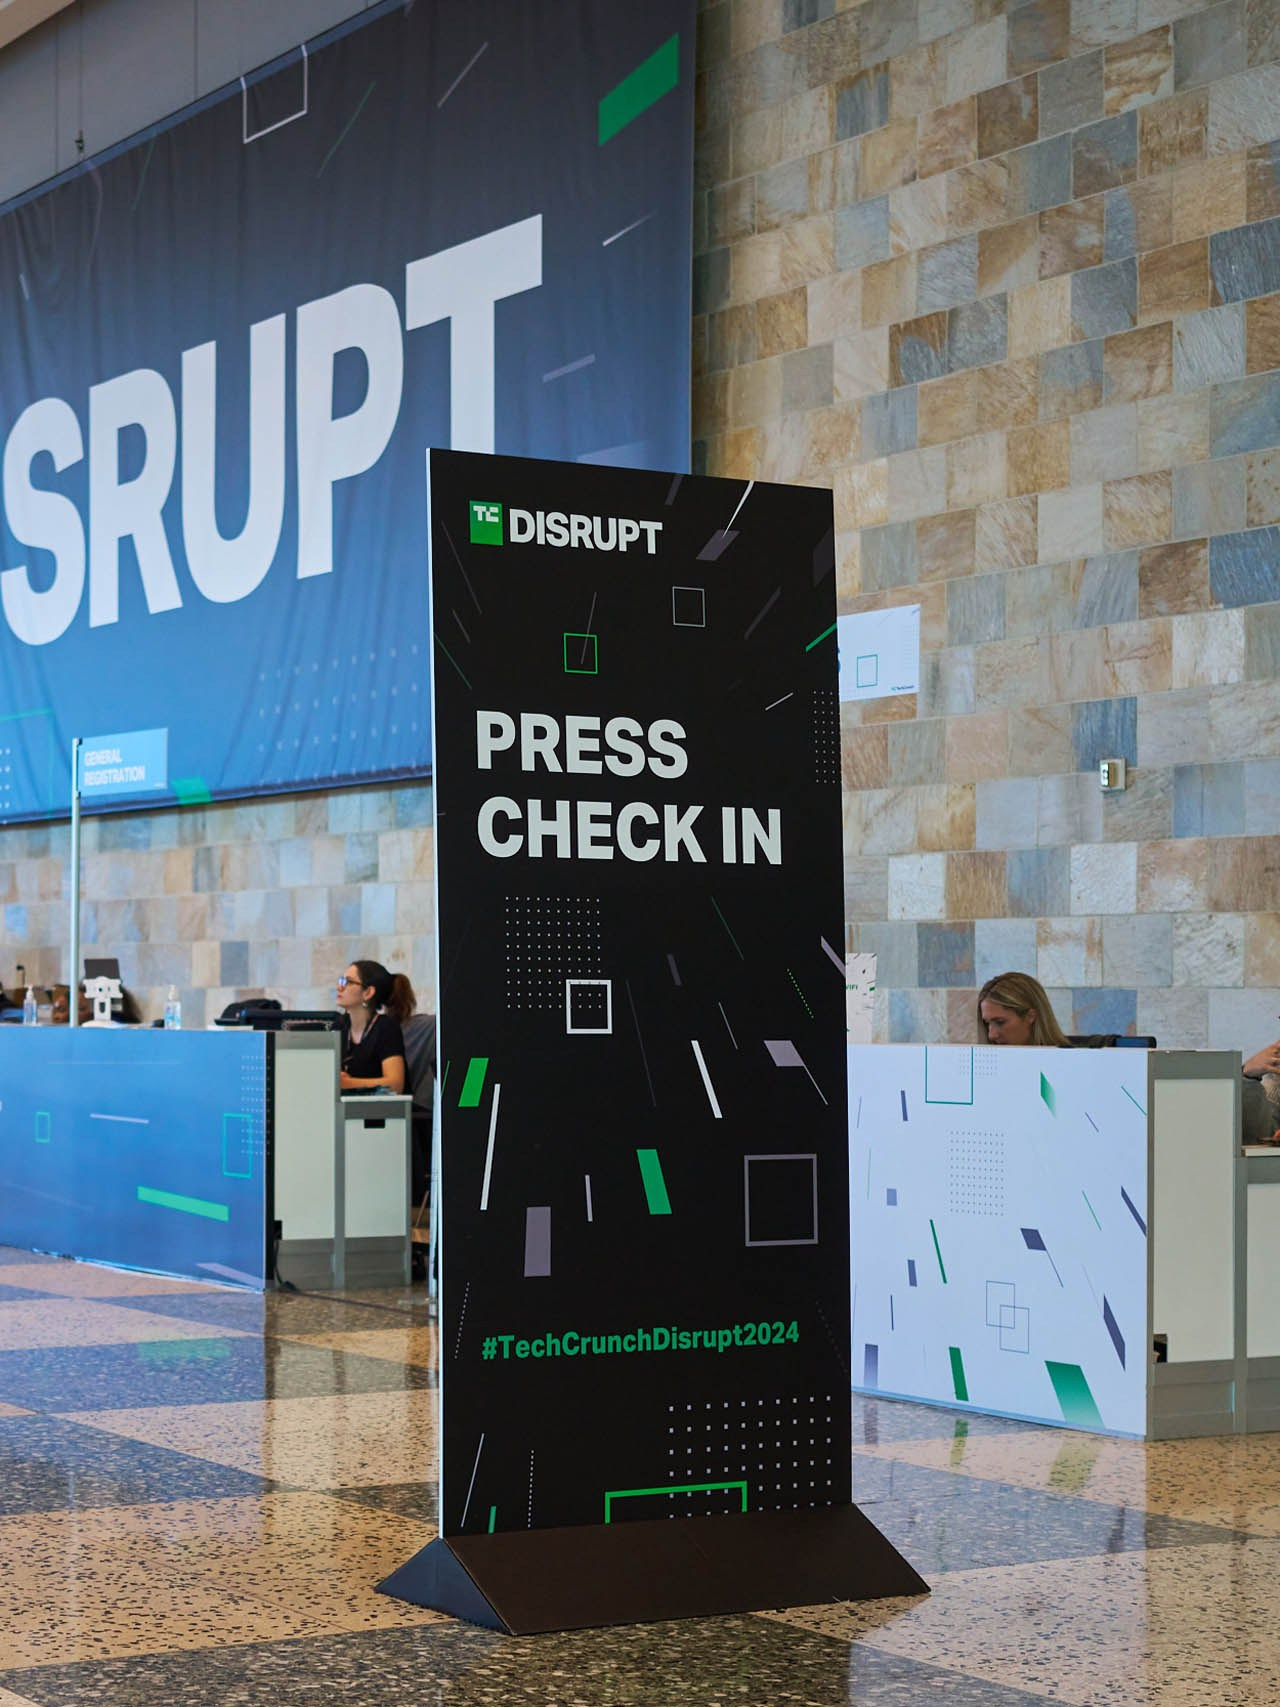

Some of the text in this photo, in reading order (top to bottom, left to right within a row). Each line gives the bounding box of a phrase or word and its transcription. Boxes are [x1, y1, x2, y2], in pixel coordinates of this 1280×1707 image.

[472, 504, 663, 554] TC DISRUPT
[84, 748, 122, 767] GENERAL
[476, 710, 688, 778] PRESS
[84, 766, 144, 786] REGISTRATION
[477, 796, 782, 865] CHECK IN
[482, 1321, 800, 1360] #TechCrunchDisrupt2024
